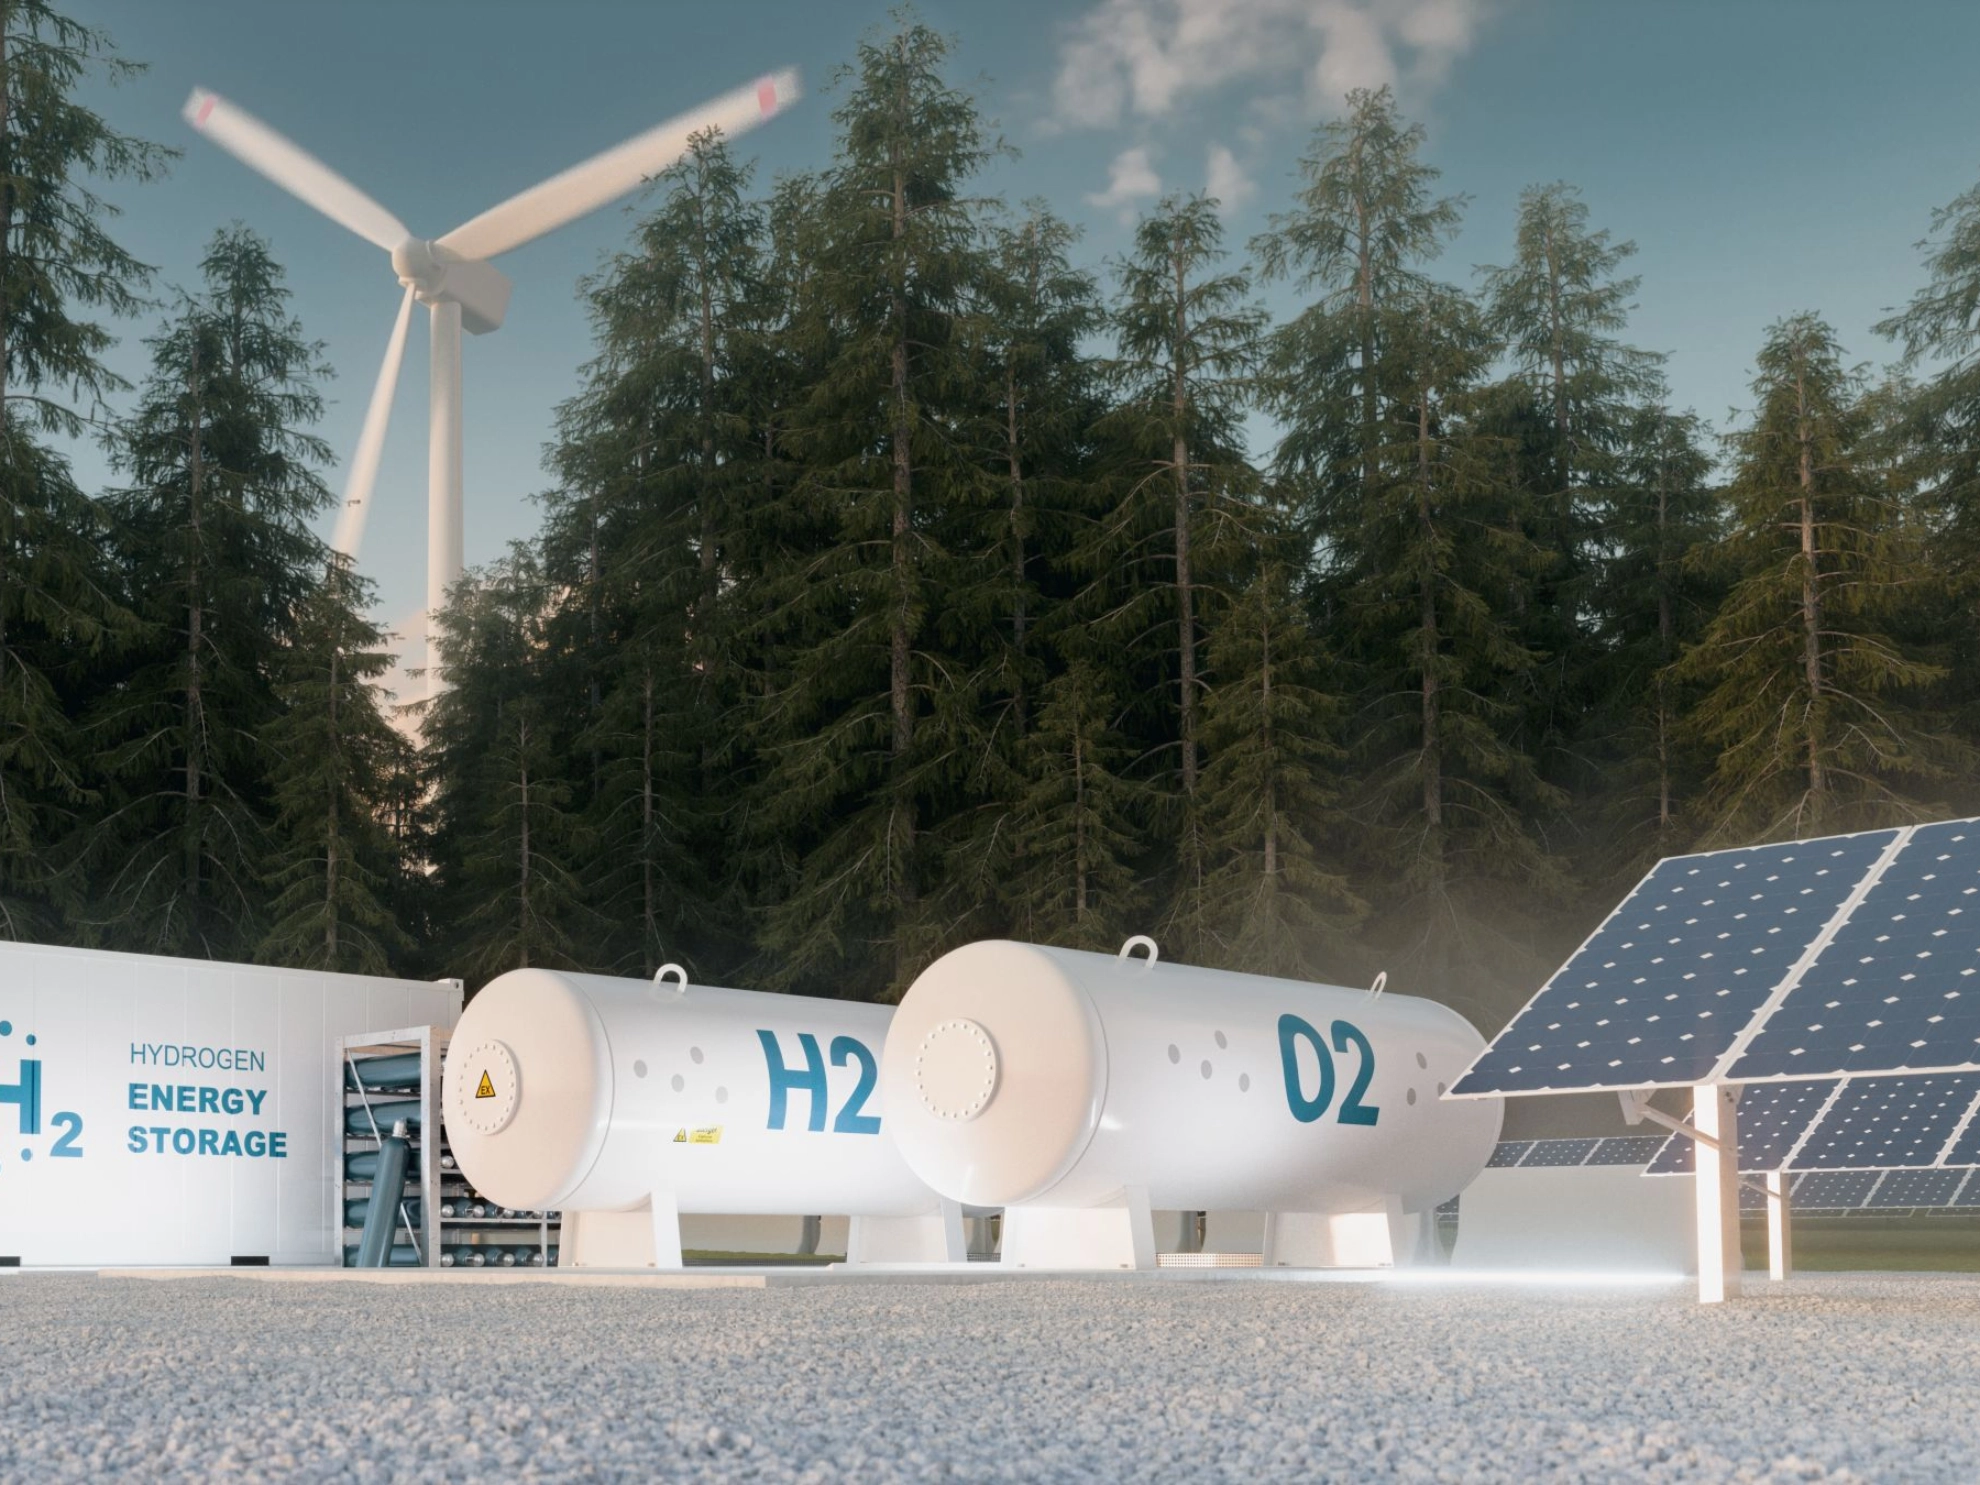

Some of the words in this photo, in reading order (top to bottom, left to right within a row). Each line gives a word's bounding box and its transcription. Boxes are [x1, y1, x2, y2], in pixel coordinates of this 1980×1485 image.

[131, 1043, 265, 1072] HYDROGEN
[481, 1086, 491, 1095] EX
[757, 1029, 882, 1135] H2
[128, 1083, 268, 1116] ENERGY
[127, 1126, 288, 1158] STORAGE
